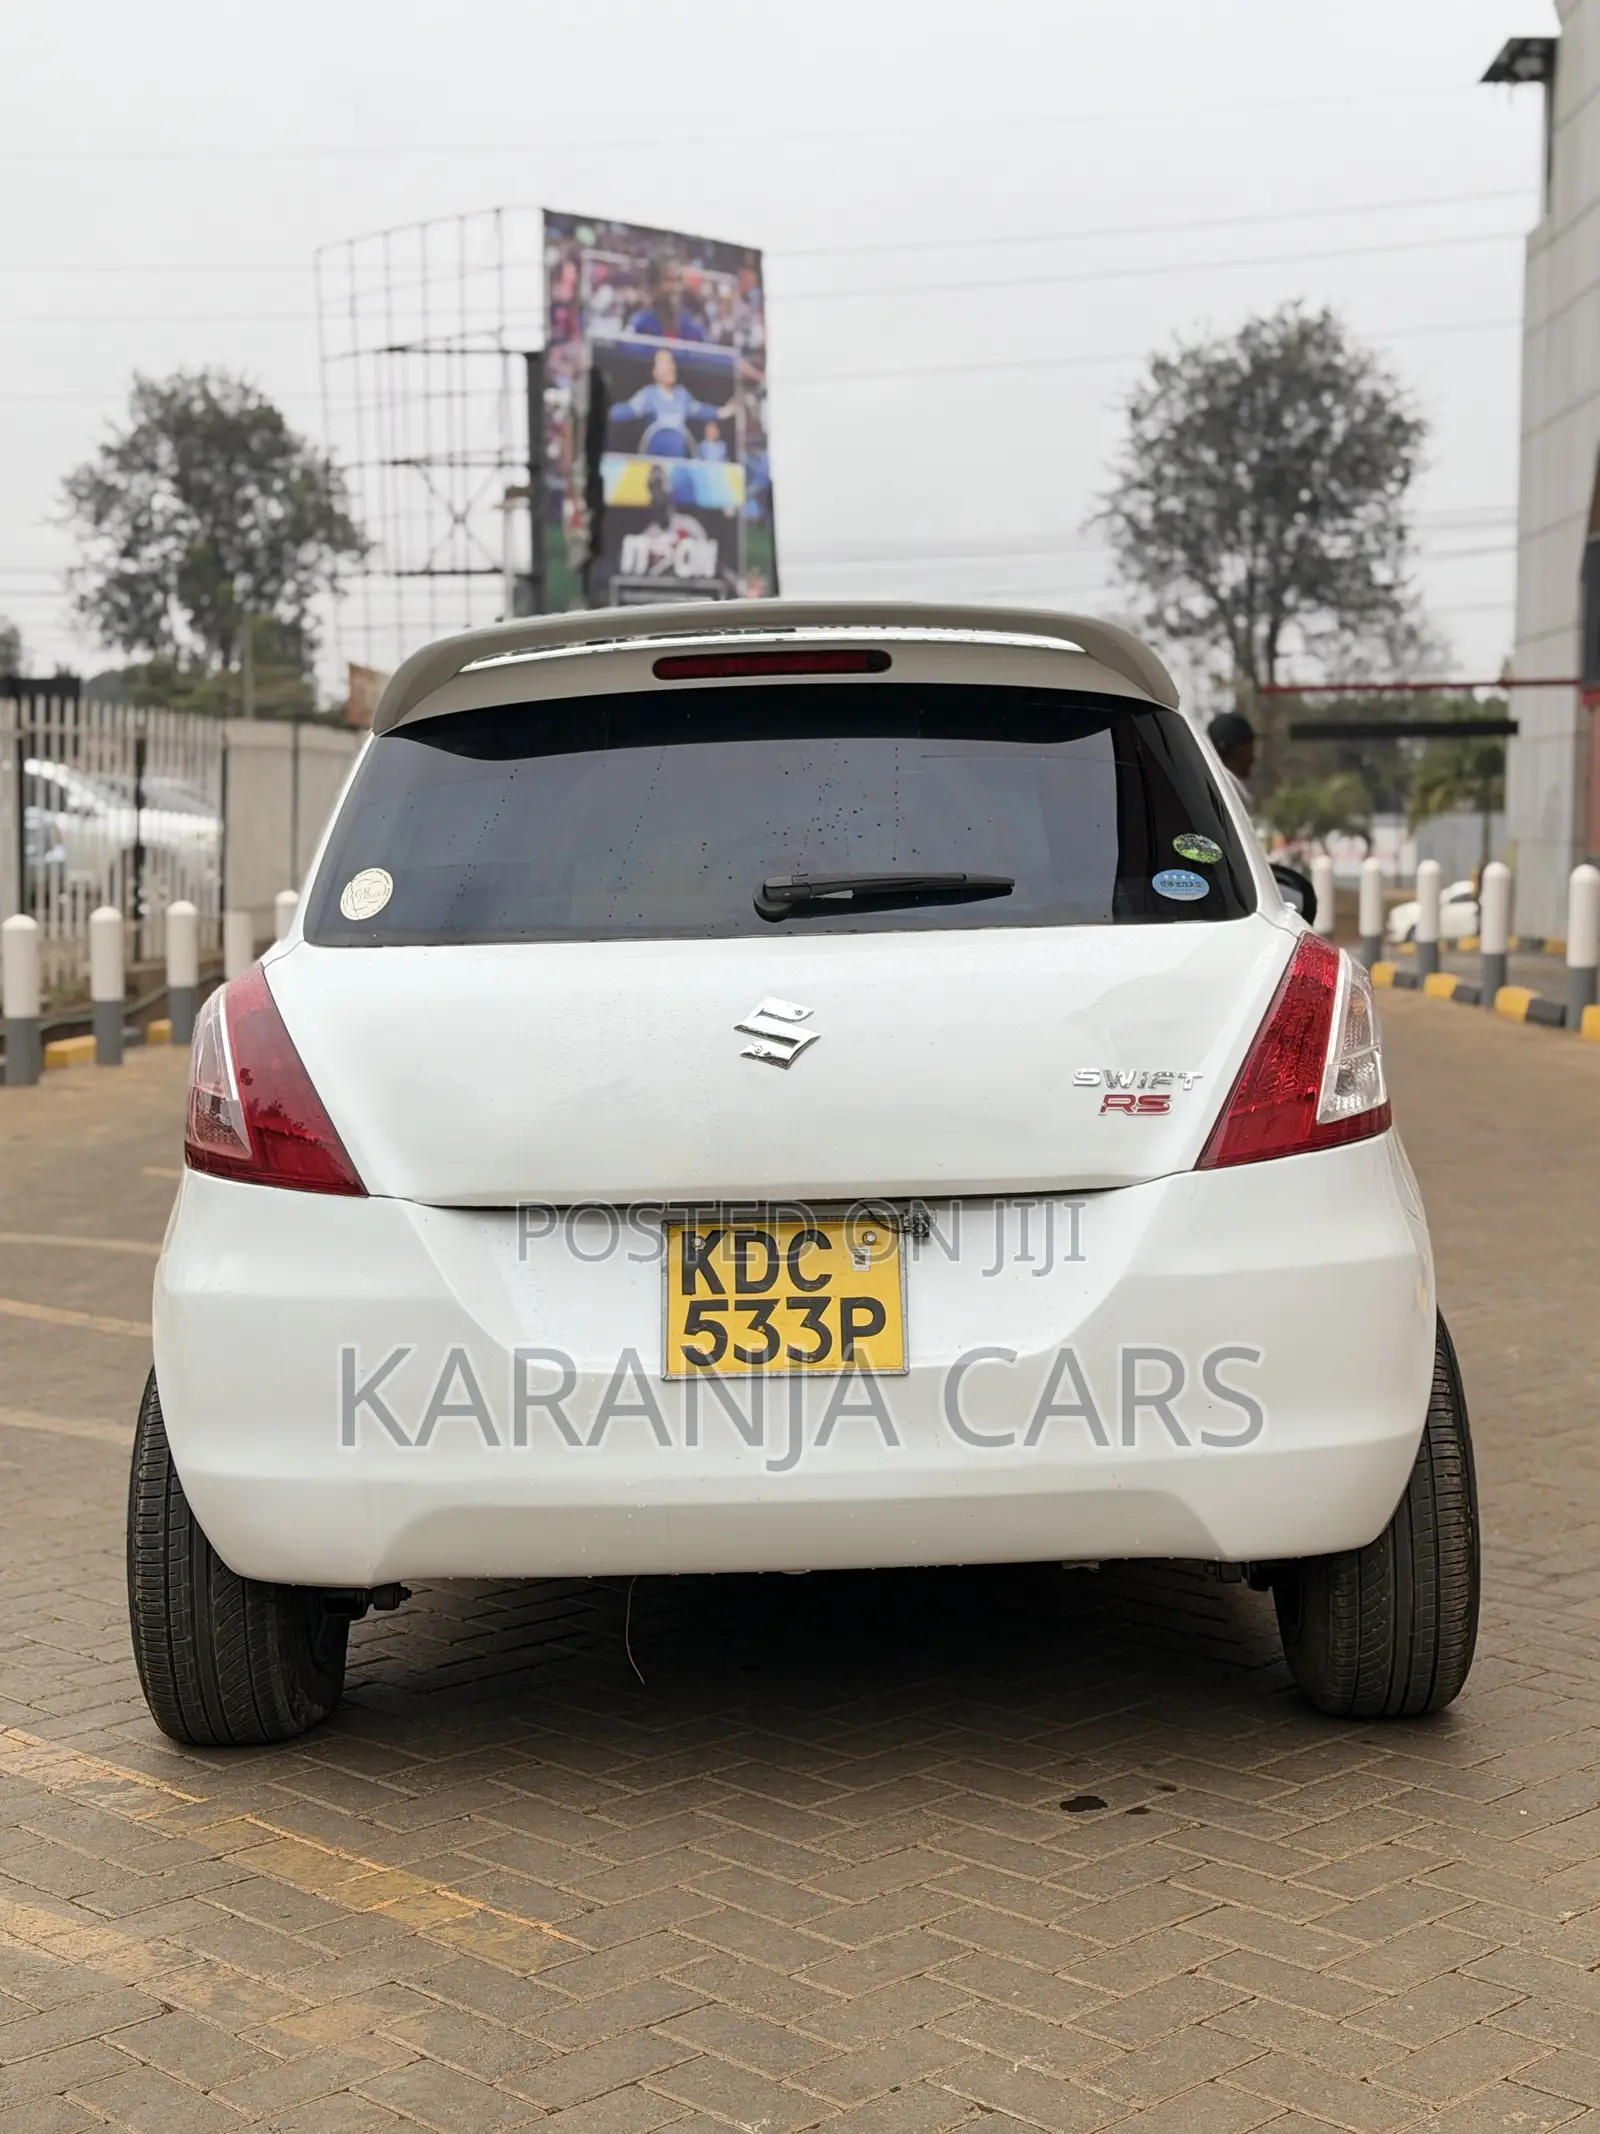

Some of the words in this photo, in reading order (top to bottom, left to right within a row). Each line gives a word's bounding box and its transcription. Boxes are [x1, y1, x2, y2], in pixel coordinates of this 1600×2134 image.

[1073, 1068, 1203, 1090] SWIFT
[1098, 1094, 1172, 1116] RS
[681, 1228, 833, 1296] KDC
[680, 1296, 886, 1367] 533P
